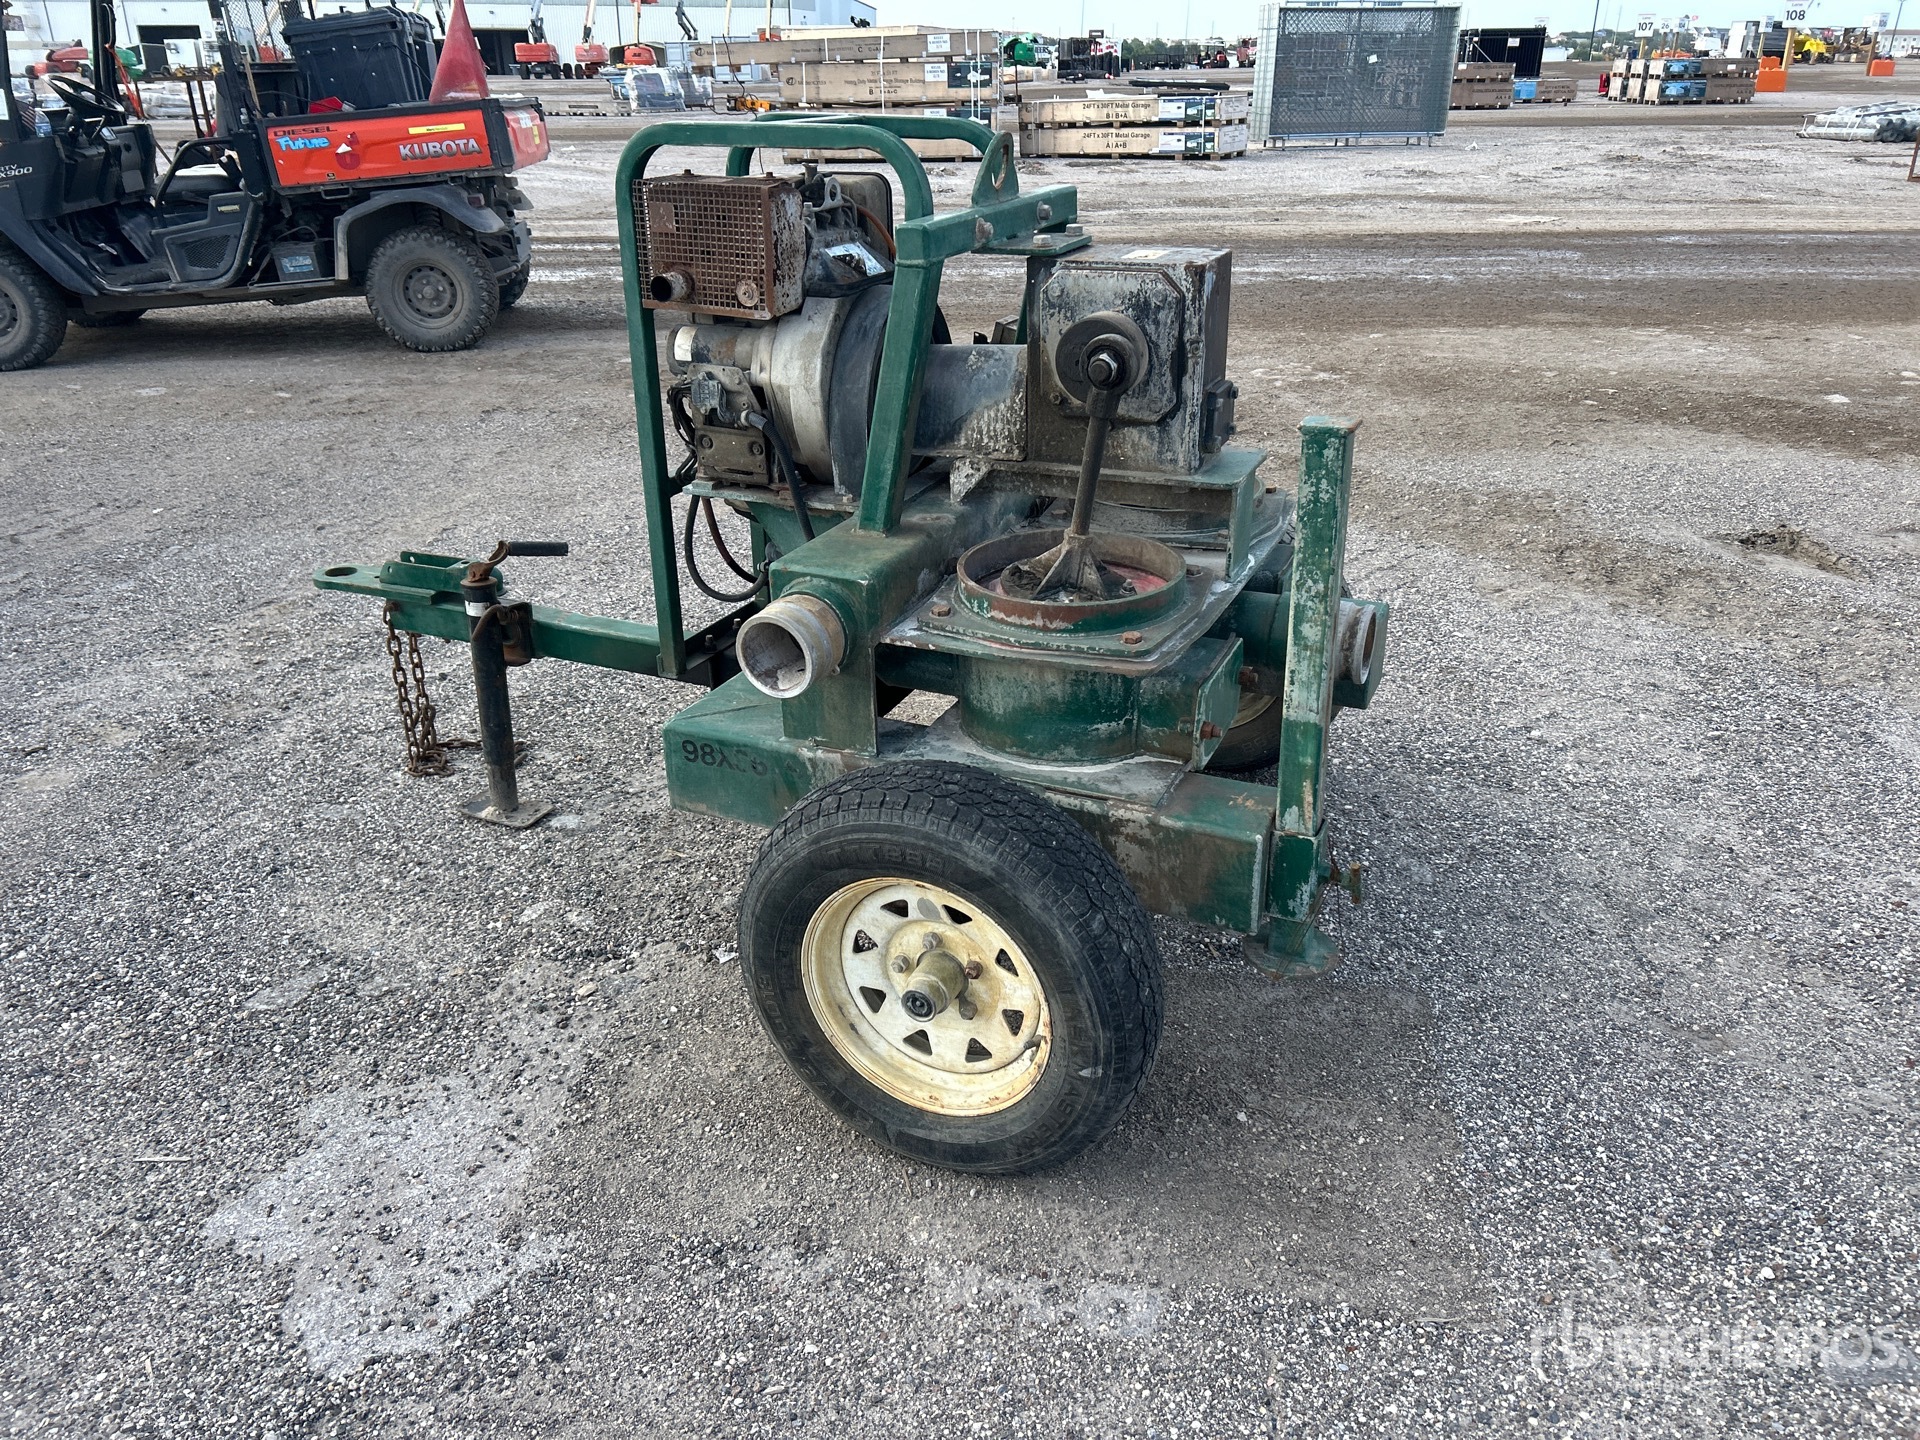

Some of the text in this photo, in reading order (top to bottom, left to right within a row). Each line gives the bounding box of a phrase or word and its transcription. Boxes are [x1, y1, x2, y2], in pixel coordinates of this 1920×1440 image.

[1785, 9, 1806, 21] 108
[1638, 22, 1654, 31] 107
[1131, 102, 1151, 110] Garage
[273, 125, 338, 137] DIESEL
[1131, 132, 1151, 140] Garage
[276, 136, 330, 151] Future
[399, 138, 482, 161] KUBOTA
